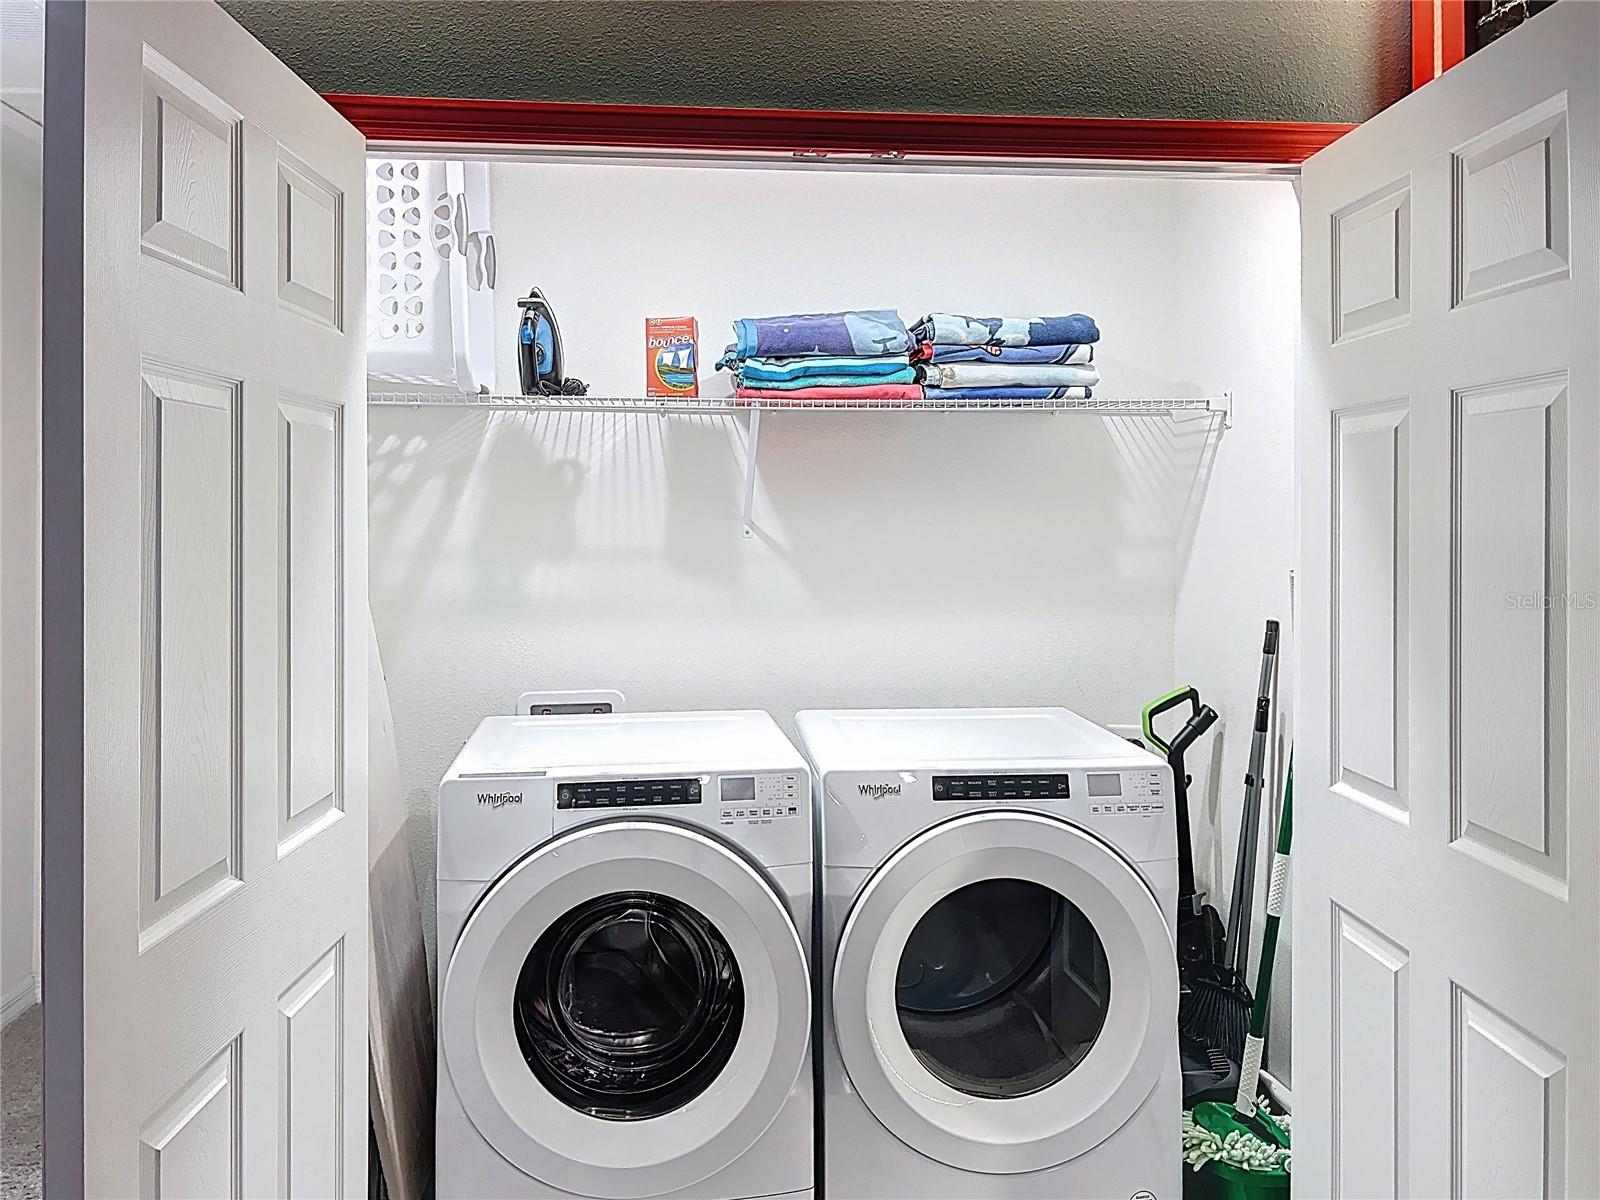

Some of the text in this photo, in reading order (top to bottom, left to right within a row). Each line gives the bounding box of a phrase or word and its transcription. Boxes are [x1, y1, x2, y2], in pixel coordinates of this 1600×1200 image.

[649, 335, 690, 348] bounce
[858, 784, 901, 799] Whirlpool
[477, 792, 523, 808] Whirlpool
